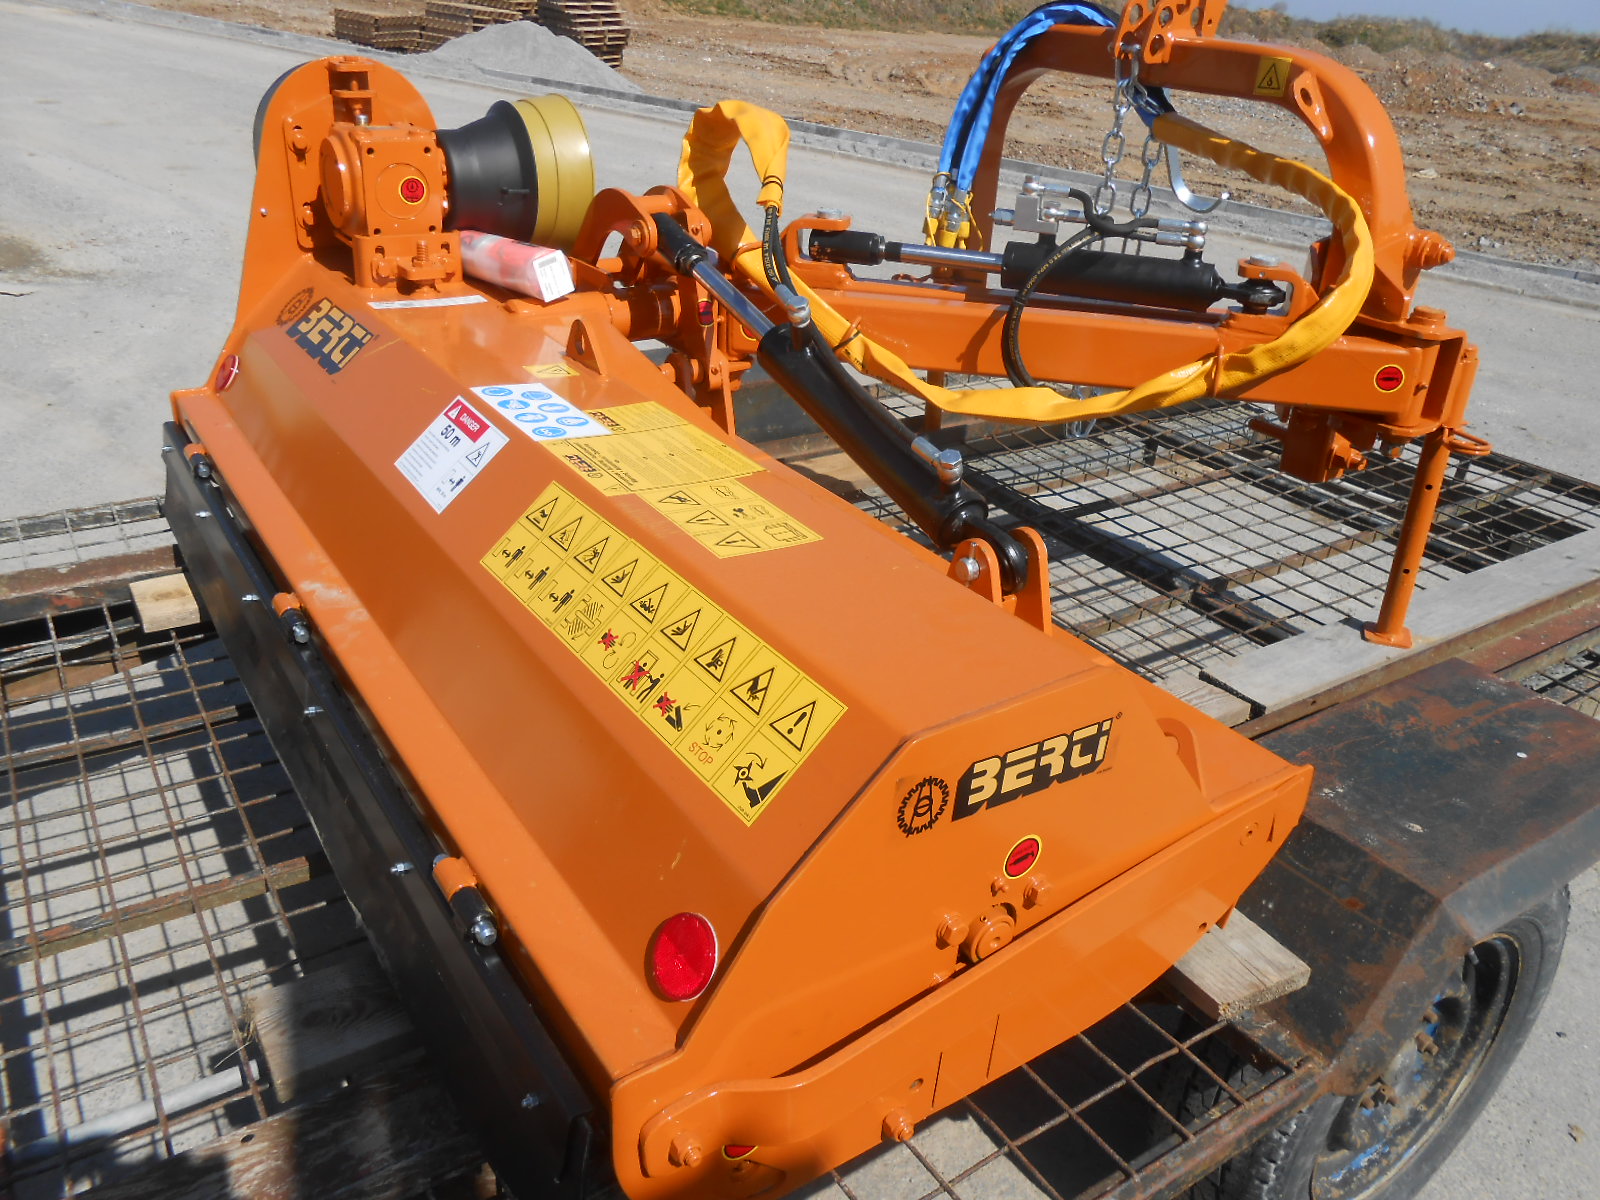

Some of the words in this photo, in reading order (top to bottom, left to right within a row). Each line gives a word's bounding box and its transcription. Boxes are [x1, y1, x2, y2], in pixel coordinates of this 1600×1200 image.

[286, 296, 374, 375] BERTI
[459, 412, 481, 433] DANGER
[440, 424, 456, 440] 50
[449, 435, 462, 448] m
[687, 740, 715, 766] STOP
[952, 717, 1114, 822] BERTI
